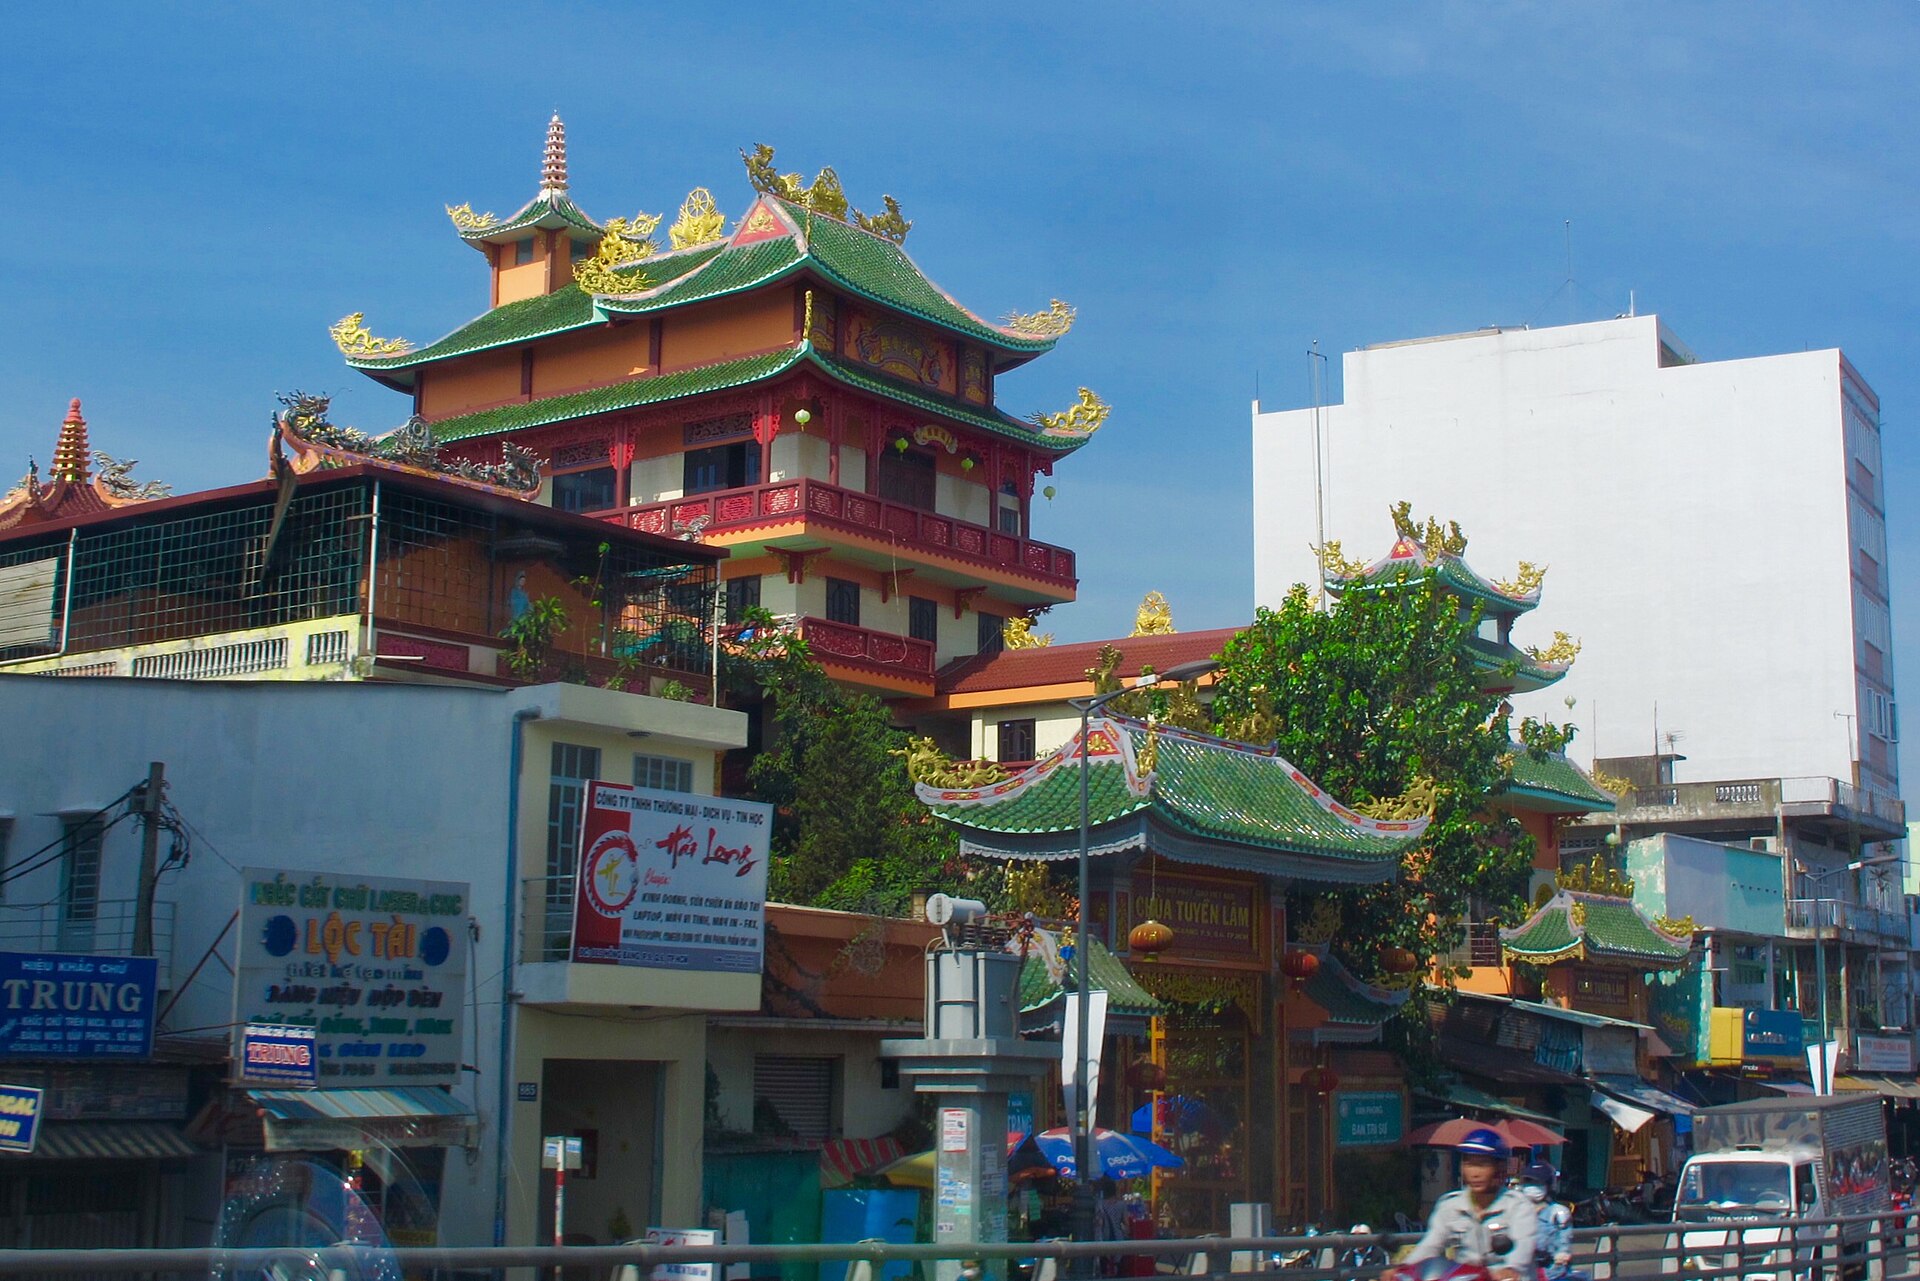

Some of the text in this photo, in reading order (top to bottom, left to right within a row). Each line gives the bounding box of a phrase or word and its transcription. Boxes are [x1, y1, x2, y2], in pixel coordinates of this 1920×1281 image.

[307, 911, 416, 966] LỘC TÀI
[21, 958, 54, 973] HIỆU
[2, 979, 143, 1013] TRUNG
[247, 1042, 311, 1066] TRUNG
[1107, 1153, 1139, 1167] pepsi
